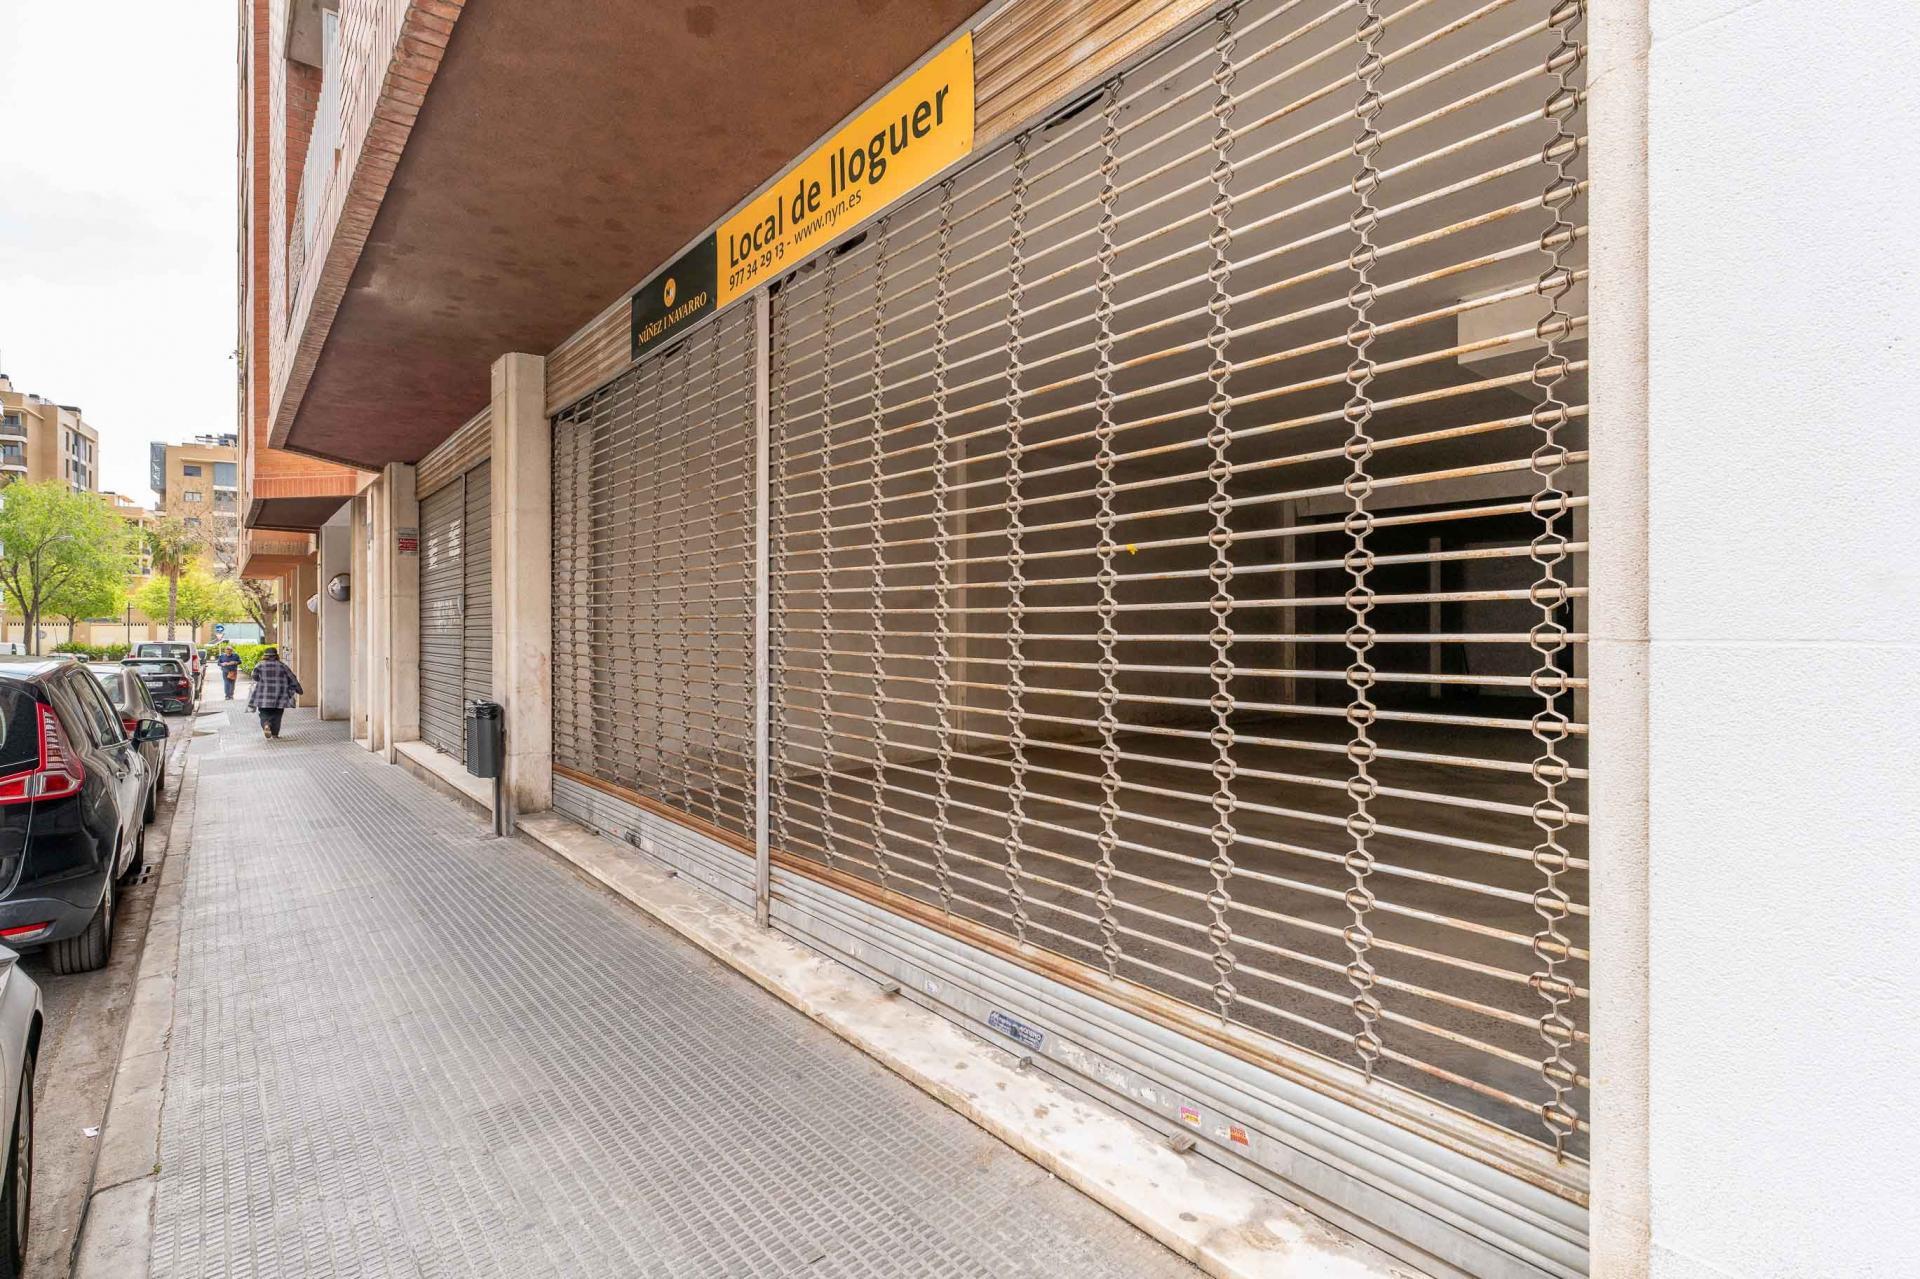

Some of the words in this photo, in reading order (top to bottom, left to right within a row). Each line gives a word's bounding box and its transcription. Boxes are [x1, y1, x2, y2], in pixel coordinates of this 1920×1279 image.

[730, 196, 783, 269] Local
[791, 178, 821, 226] de
[830, 84, 949, 198] lloguer
[729, 268, 745, 292] 977
[747, 260, 758, 280] 34
[760, 250, 772, 268] 29
[775, 242, 784, 260] 13
[794, 189, 862, 245] www.nyn.es
[638, 320, 663, 346] NÚÑEZ
[668, 291, 707, 328] NAVARRO
